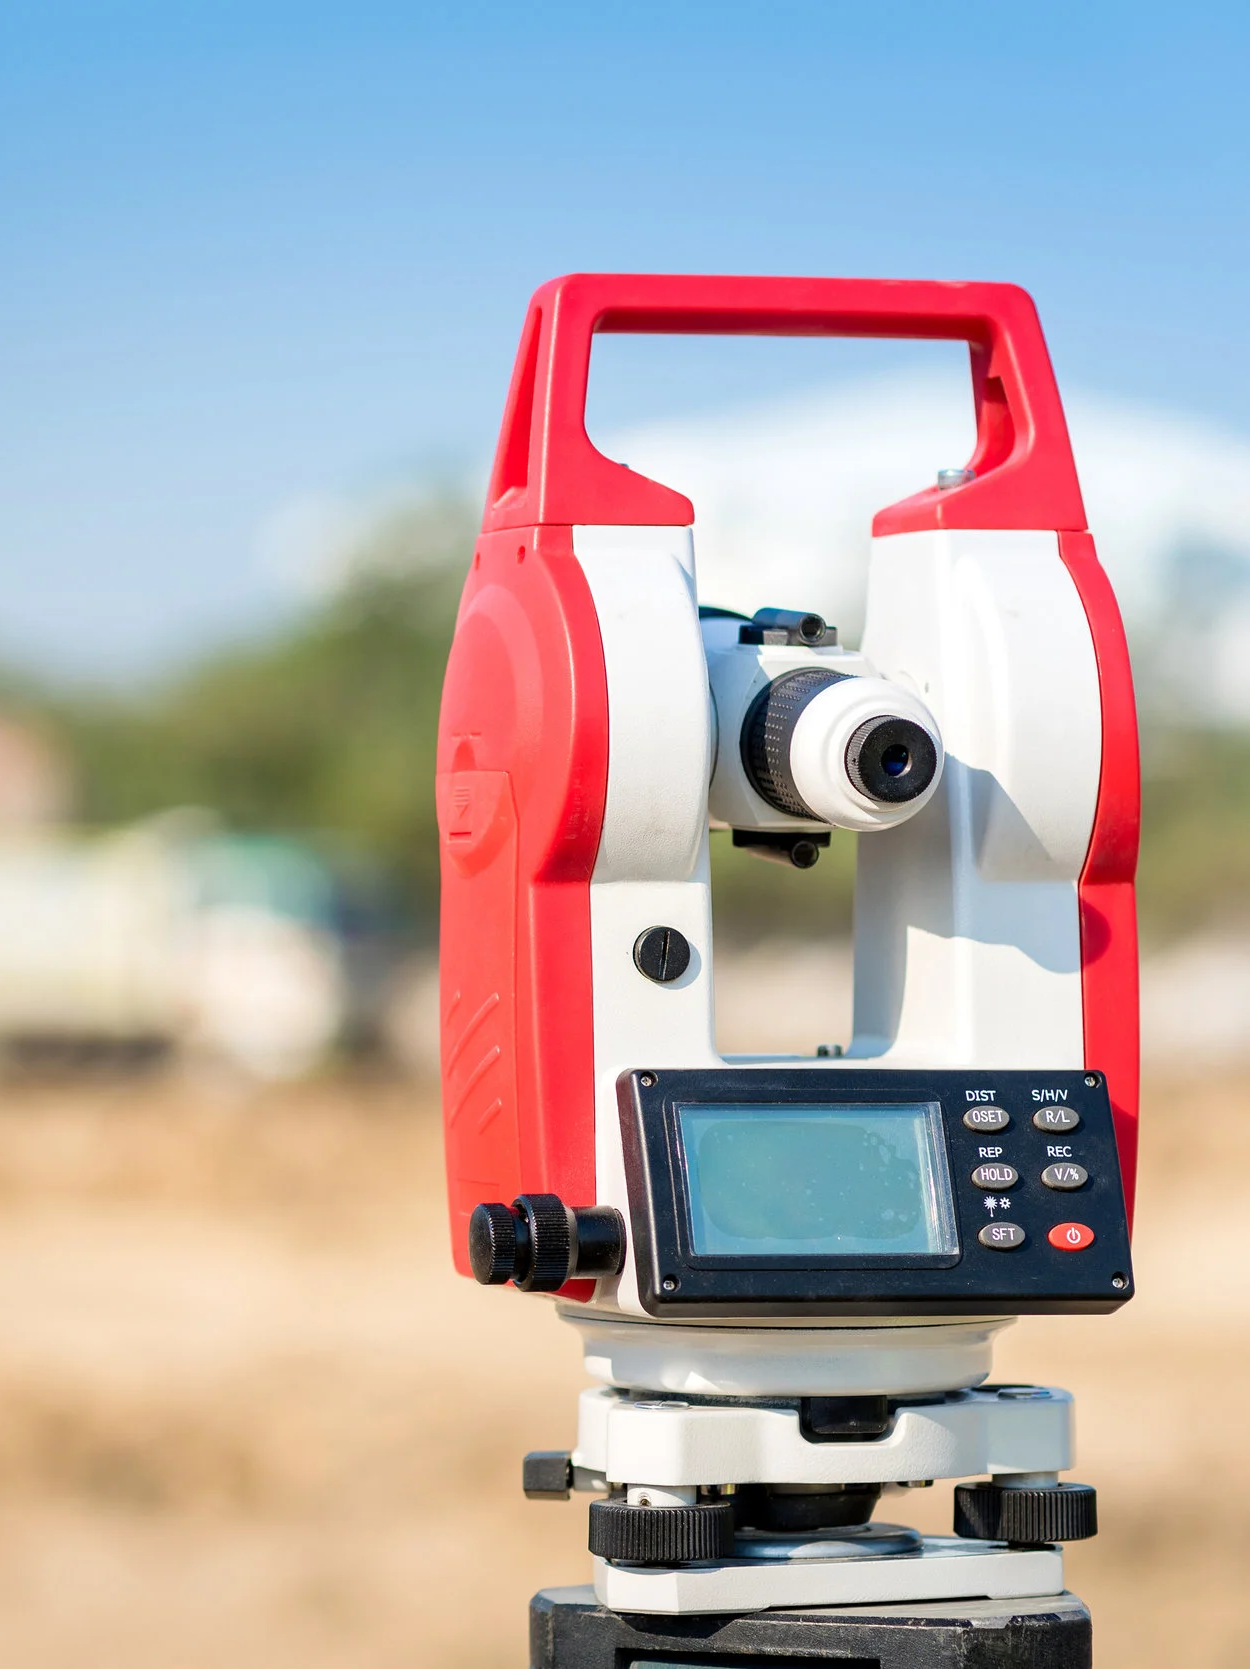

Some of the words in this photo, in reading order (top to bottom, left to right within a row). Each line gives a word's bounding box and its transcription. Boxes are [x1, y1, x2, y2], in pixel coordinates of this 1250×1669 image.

[965, 1090, 996, 1101] DIST
[1031, 1089, 1068, 1102] S/H/V
[1045, 1110, 1070, 1123] R/L
[978, 1147, 1003, 1158] REP
[1046, 1146, 1072, 1157] REC
[980, 1168, 1013, 1181] HOLD
[1054, 1168, 1079, 1180] V/%
[992, 1228, 1015, 1240] SFT
